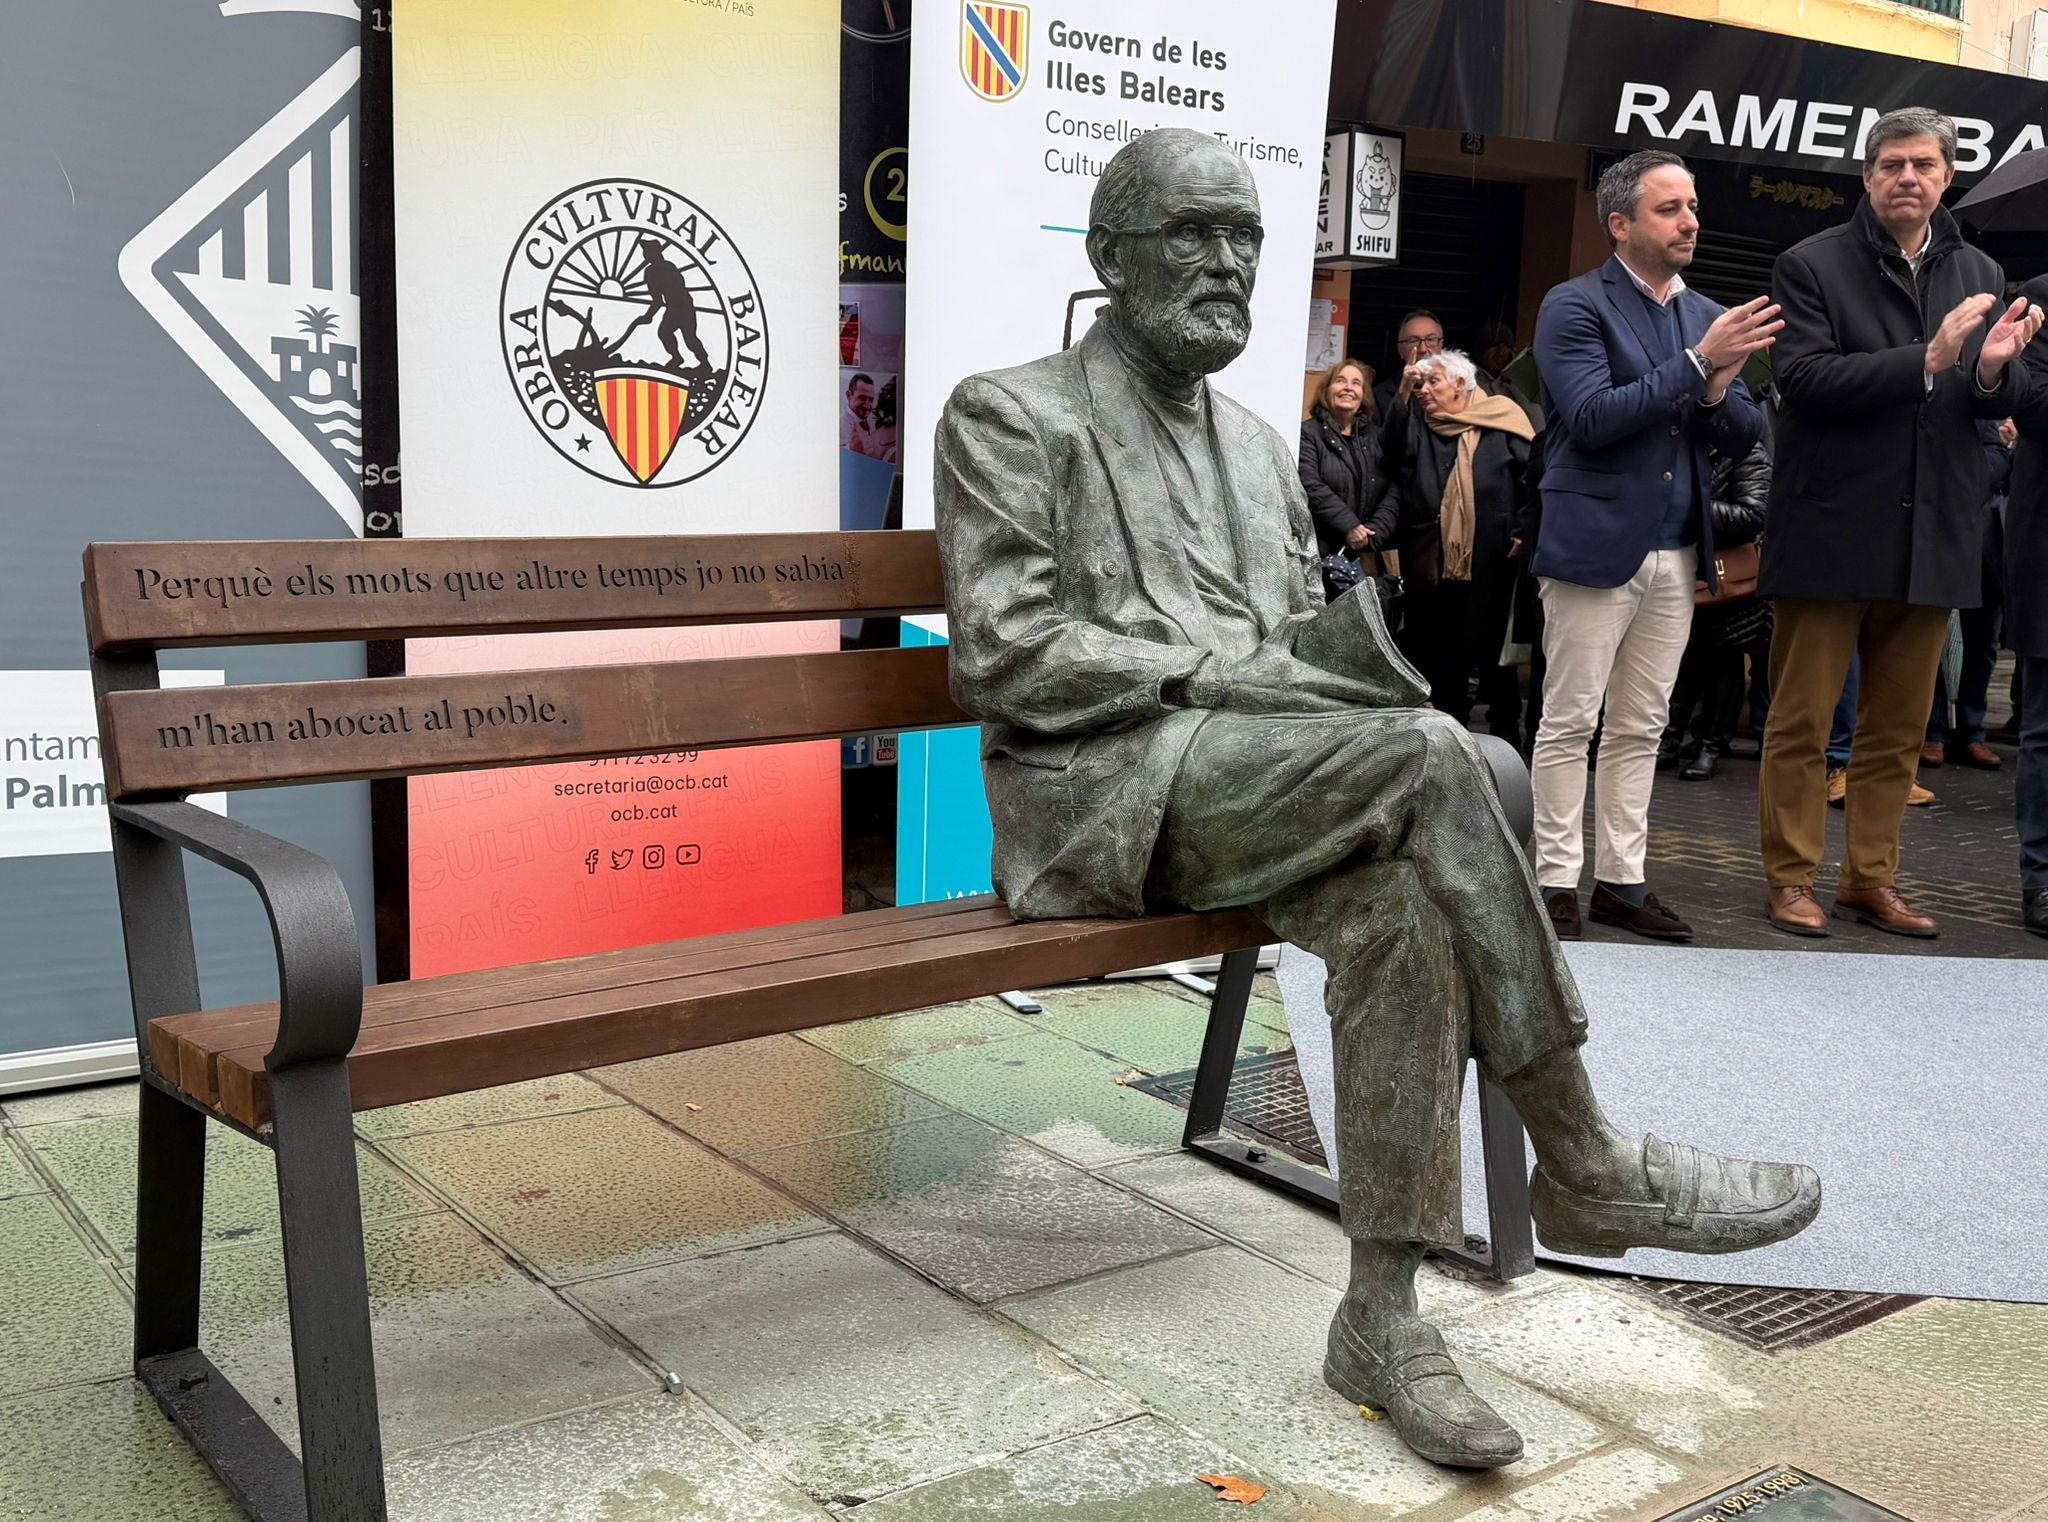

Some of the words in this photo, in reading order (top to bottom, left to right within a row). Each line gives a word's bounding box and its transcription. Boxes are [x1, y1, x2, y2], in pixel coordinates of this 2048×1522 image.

[1048, 20, 1141, 59] Govern
[1152, 36, 1182, 64] de
[1192, 40, 1227, 71] les
[1046, 60, 1106, 96] Illes
[1120, 71, 1225, 112] Balears
[1046, 110, 1159, 142] Conselle
[1045, 149, 1108, 178] Cultu
[525, 187, 721, 270] CVLTVRAL
[1356, 234, 1391, 253] SHIFU
[839, 240, 907, 276] fman
[510, 305, 570, 430] OBRA
[693, 290, 762, 456] BALEAR
[134, 567, 273, 608] Perquè
[286, 564, 335, 597] els
[346, 567, 432, 595] mots
[444, 568, 504, 602] que
[516, 560, 588, 592] altre
[598, 562, 688, 596] temps
[696, 559, 724, 592] jo
[731, 562, 767, 585] no
[775, 555, 845, 583] sabia
[156, 712, 276, 749] m'han
[288, 706, 413, 742] abocat
[424, 699, 453, 732] al
[463, 693, 569, 738] poble.
[554, 774, 729, 797] secretaria@ocb.cat
[610, 803, 678, 822] ocb.cat
